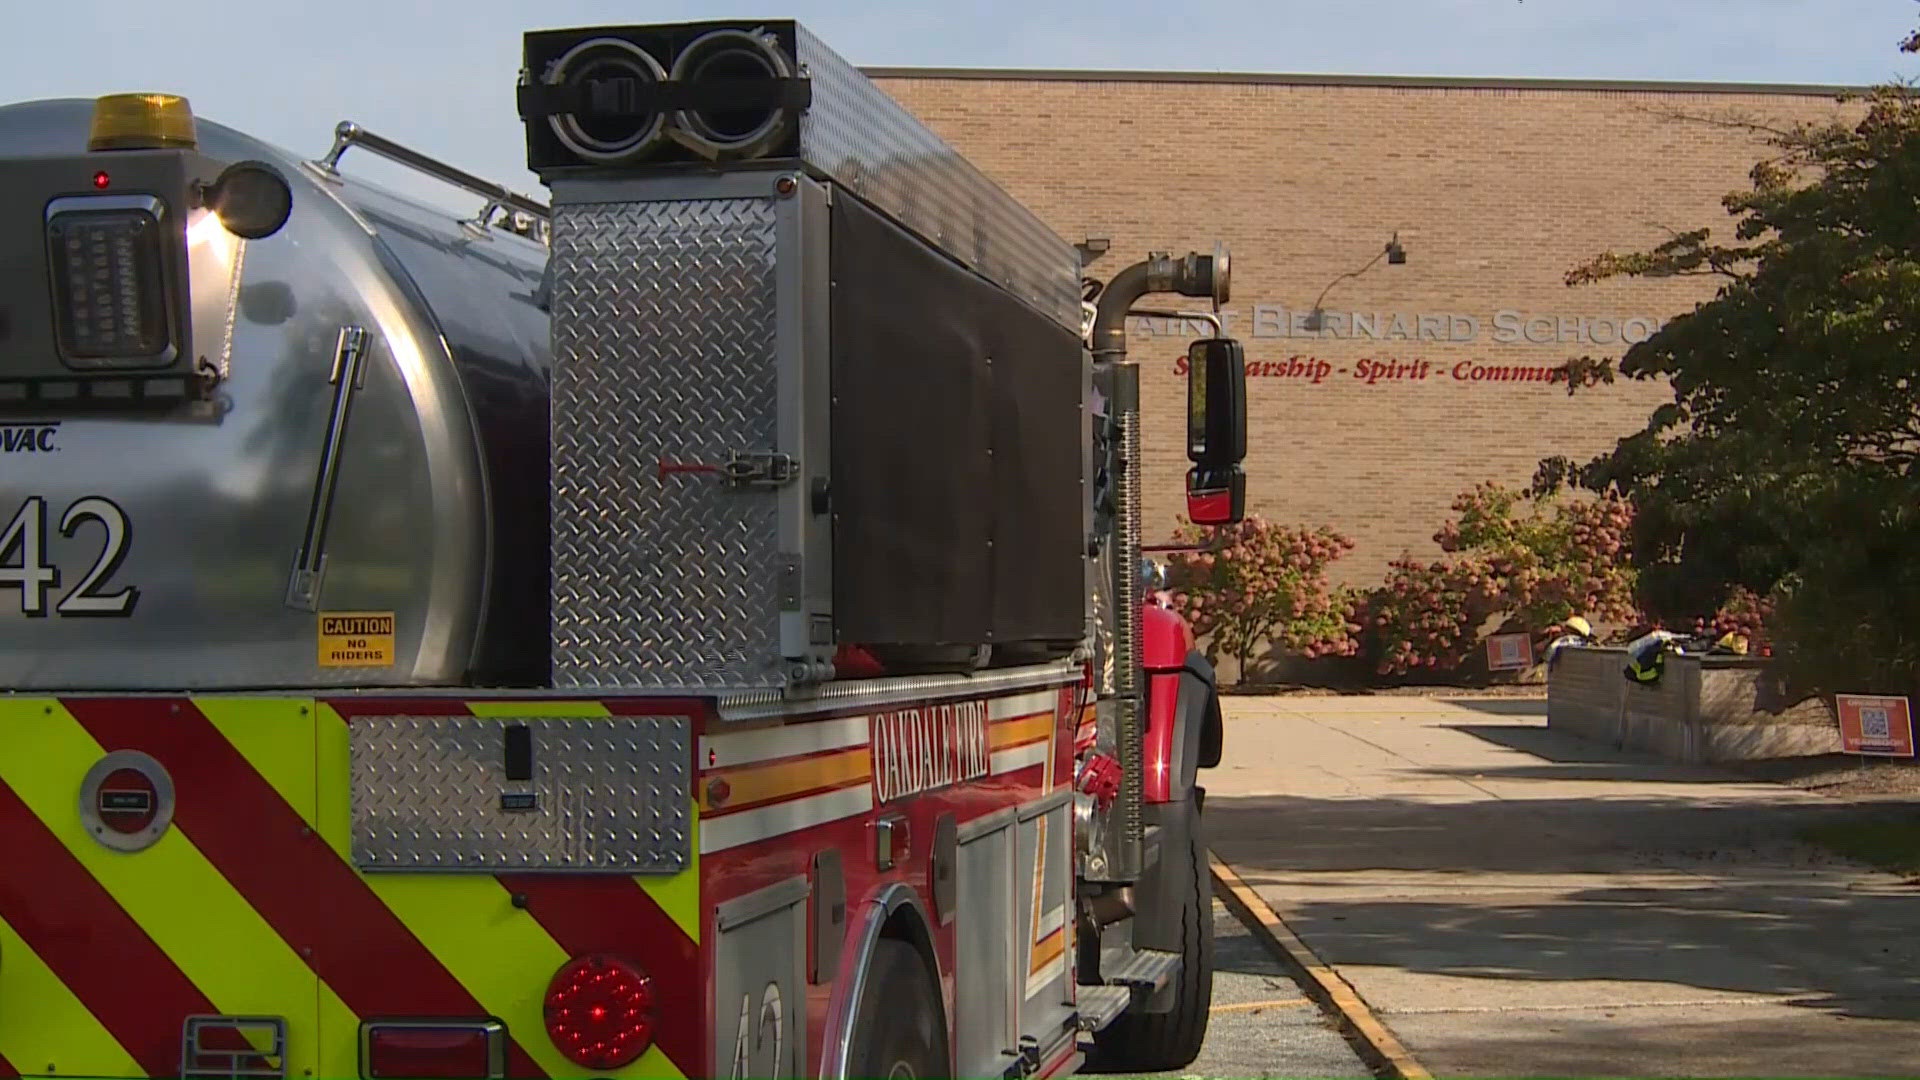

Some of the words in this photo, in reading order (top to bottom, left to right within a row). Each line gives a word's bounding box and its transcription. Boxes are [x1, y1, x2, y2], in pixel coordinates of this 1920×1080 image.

[1132, 309, 1239, 337] AINT
[1252, 303, 1481, 342] BERNARD
[1173, 354, 1331, 385] Sarship
[1353, 358, 1430, 385] Spirit
[0, 427, 57, 452] VAC
[0, 495, 140, 618] 42
[324, 618, 391, 634] CAUTION
[331, 650, 383, 660] RIDERS
[347, 639, 367, 649] NO
[874, 706, 953, 804] OAKDALE
[955, 700, 988, 783] FIRE
